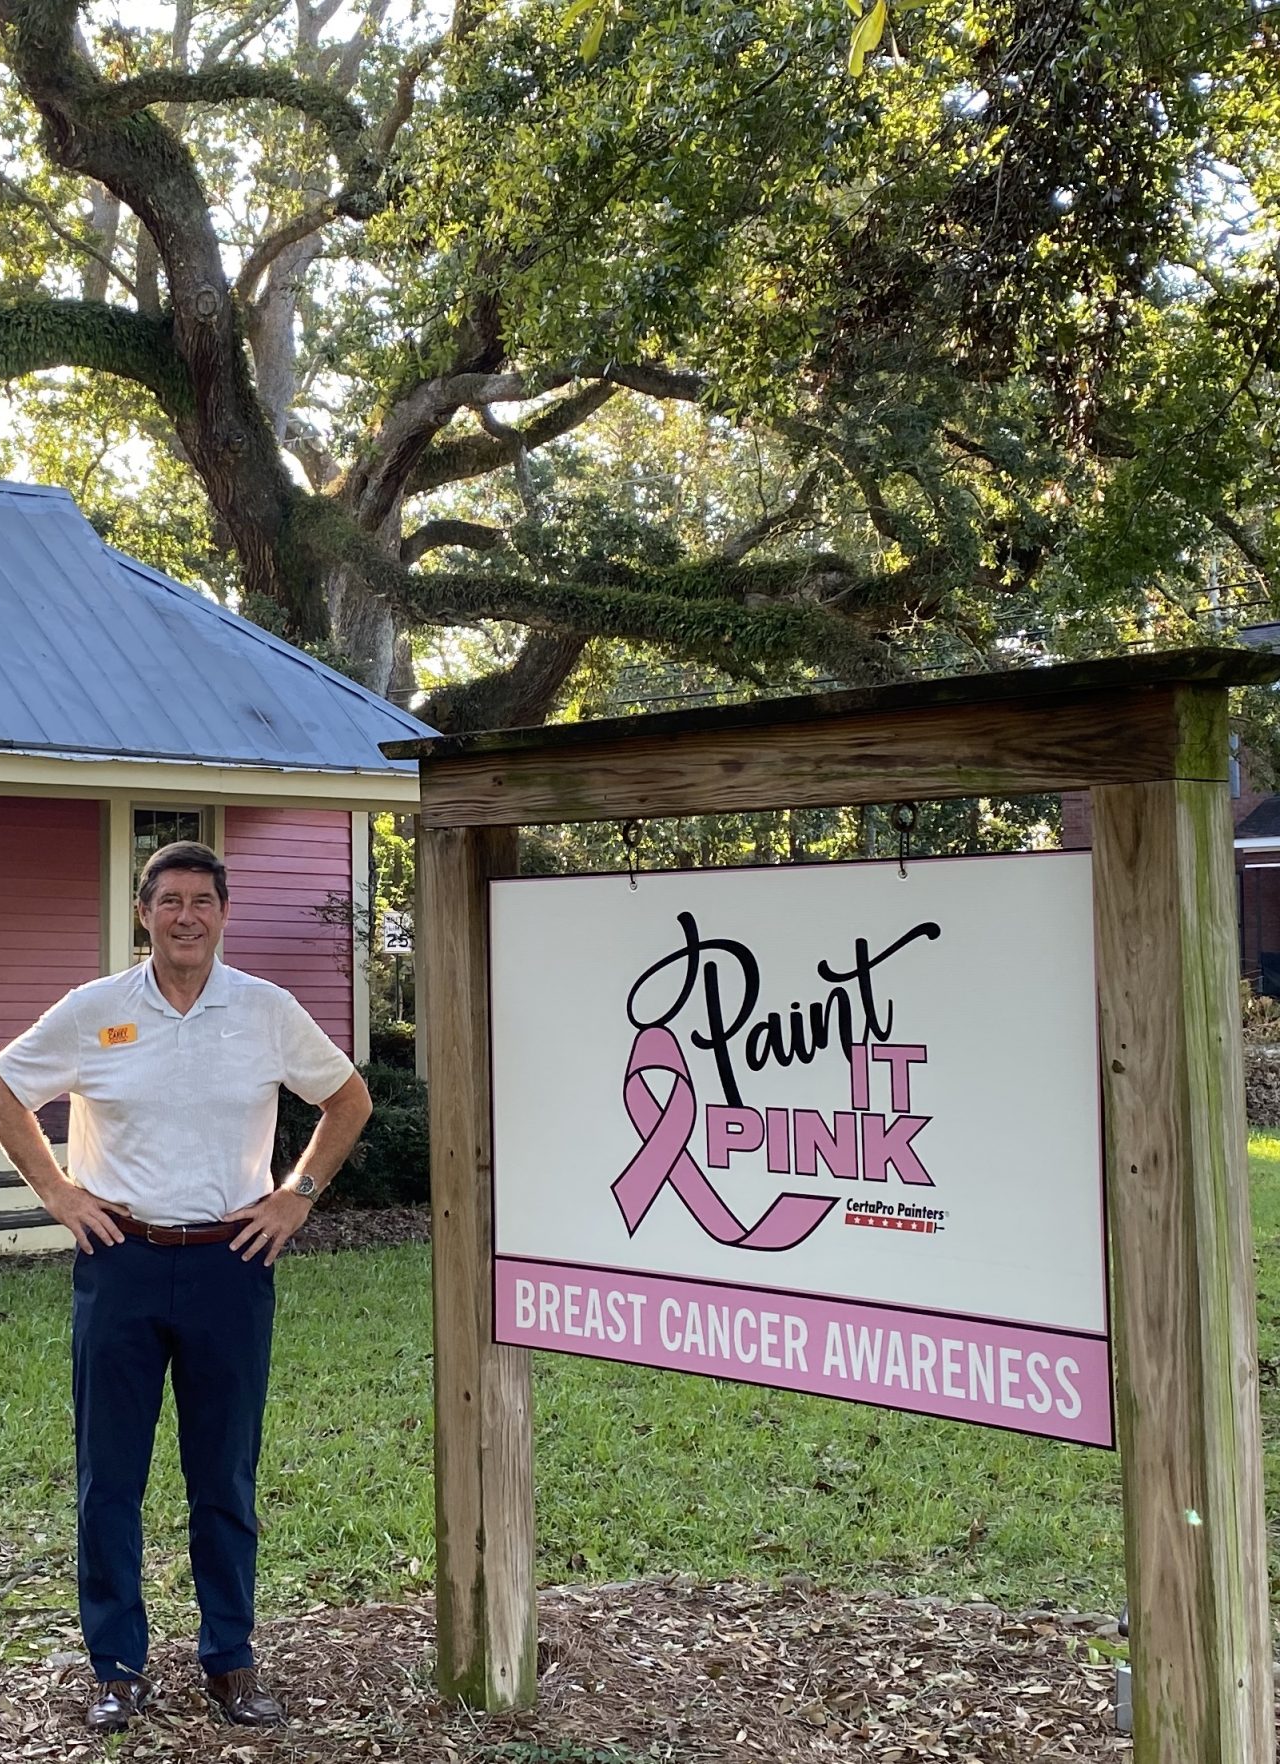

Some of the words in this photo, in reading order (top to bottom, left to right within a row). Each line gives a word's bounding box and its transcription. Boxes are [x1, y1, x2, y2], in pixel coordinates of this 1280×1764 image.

[387, 933, 409, 948] 25
[626, 911, 940, 1107] Paint
[850, 1043, 928, 1114] IT
[705, 1103, 936, 1188] PINK
[846, 1198, 894, 1216] CertaPro
[897, 1202, 945, 1220] Painters
[515, 1279, 647, 1347] BREAST
[658, 1298, 809, 1373] CANCER
[822, 1321, 1082, 1419] AWARENESS
